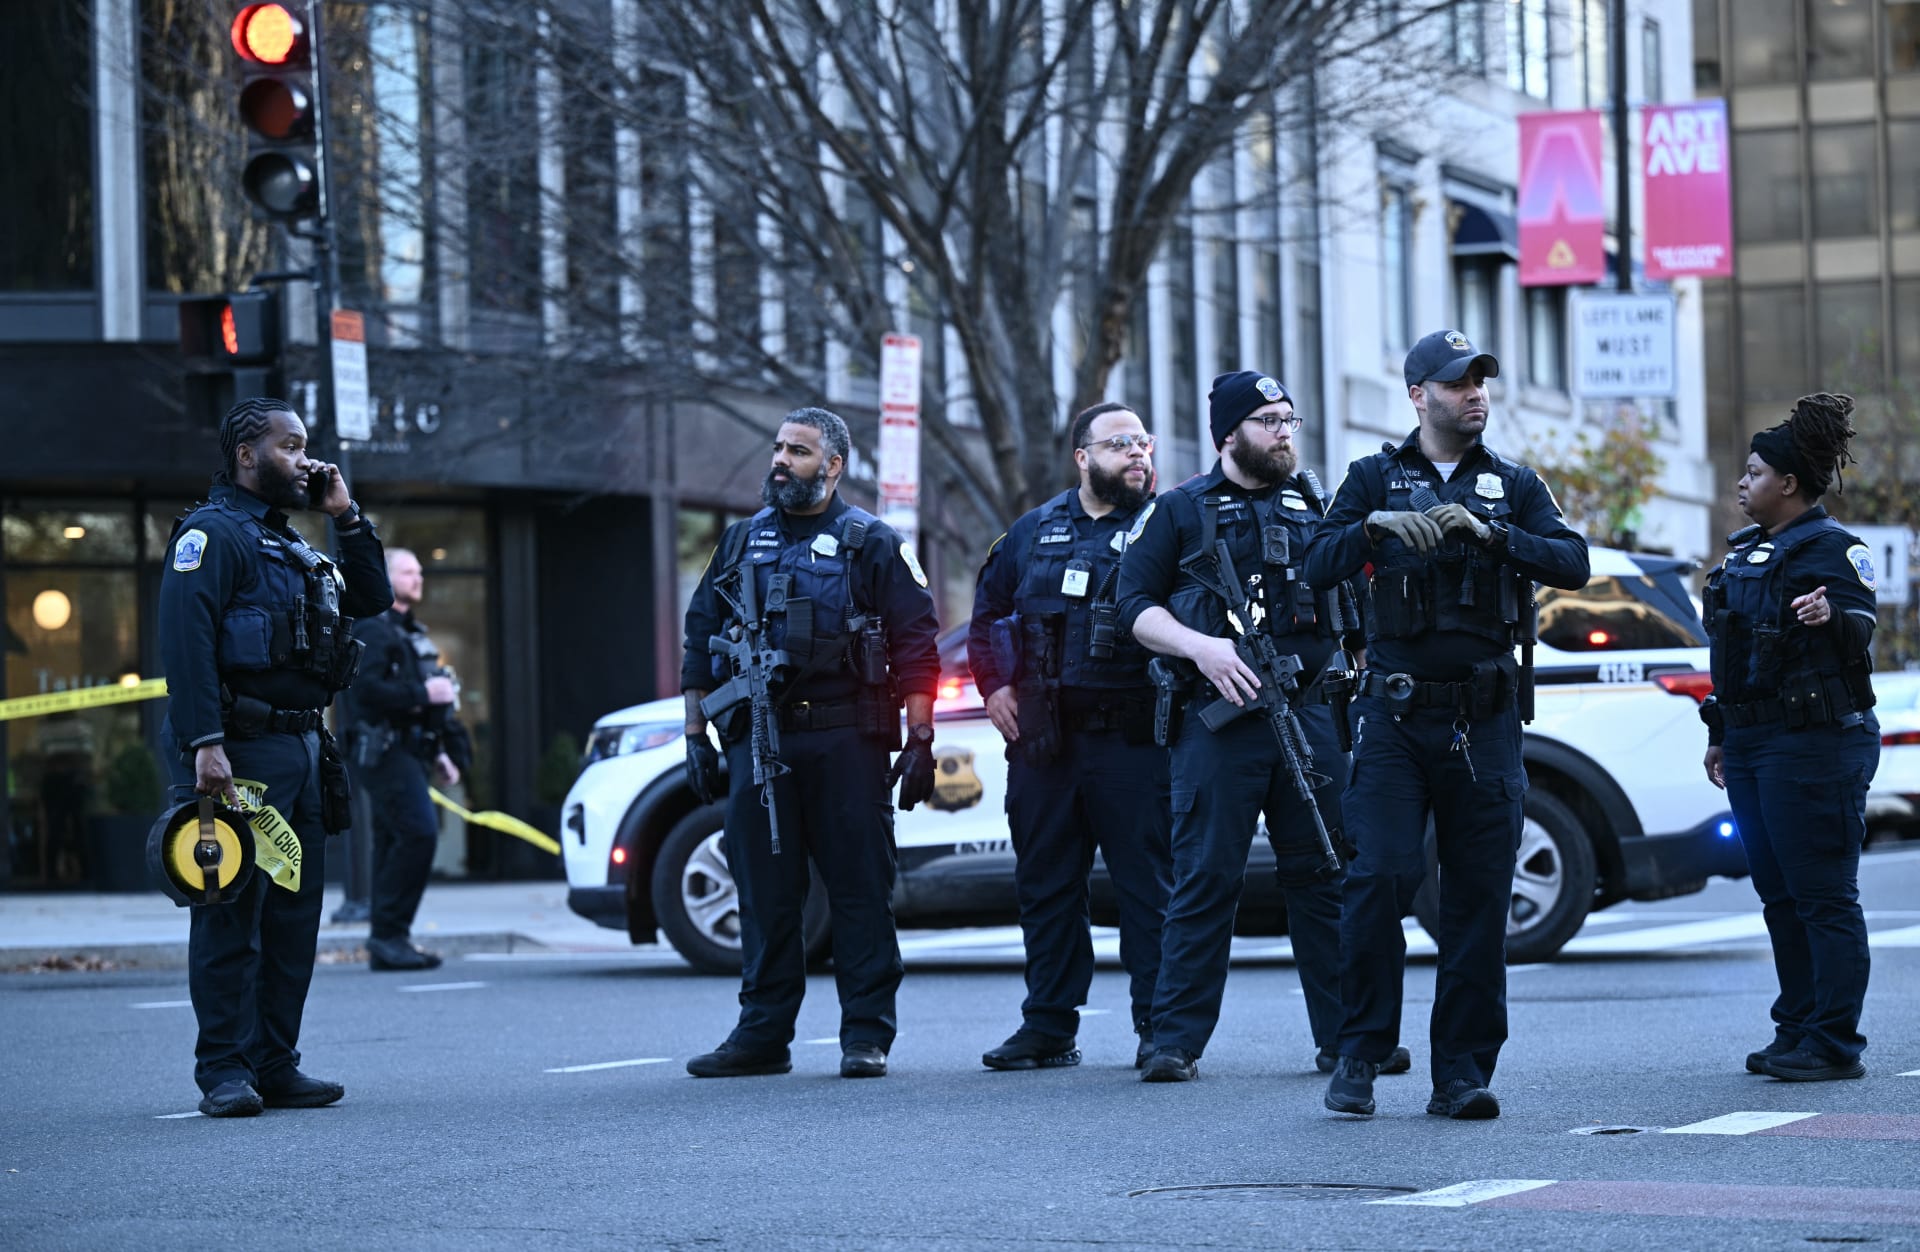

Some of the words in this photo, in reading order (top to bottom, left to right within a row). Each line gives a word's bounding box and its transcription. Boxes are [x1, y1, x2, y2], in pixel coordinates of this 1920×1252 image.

[1648, 110, 1721, 145] ART
[1648, 143, 1722, 176] AVE
[1583, 306, 1620, 327] LEFT
[1625, 307, 1664, 325] LANE
[1597, 335, 1651, 356] MUST
[1584, 367, 1622, 385] TURN
[1629, 367, 1666, 385] LEFT
